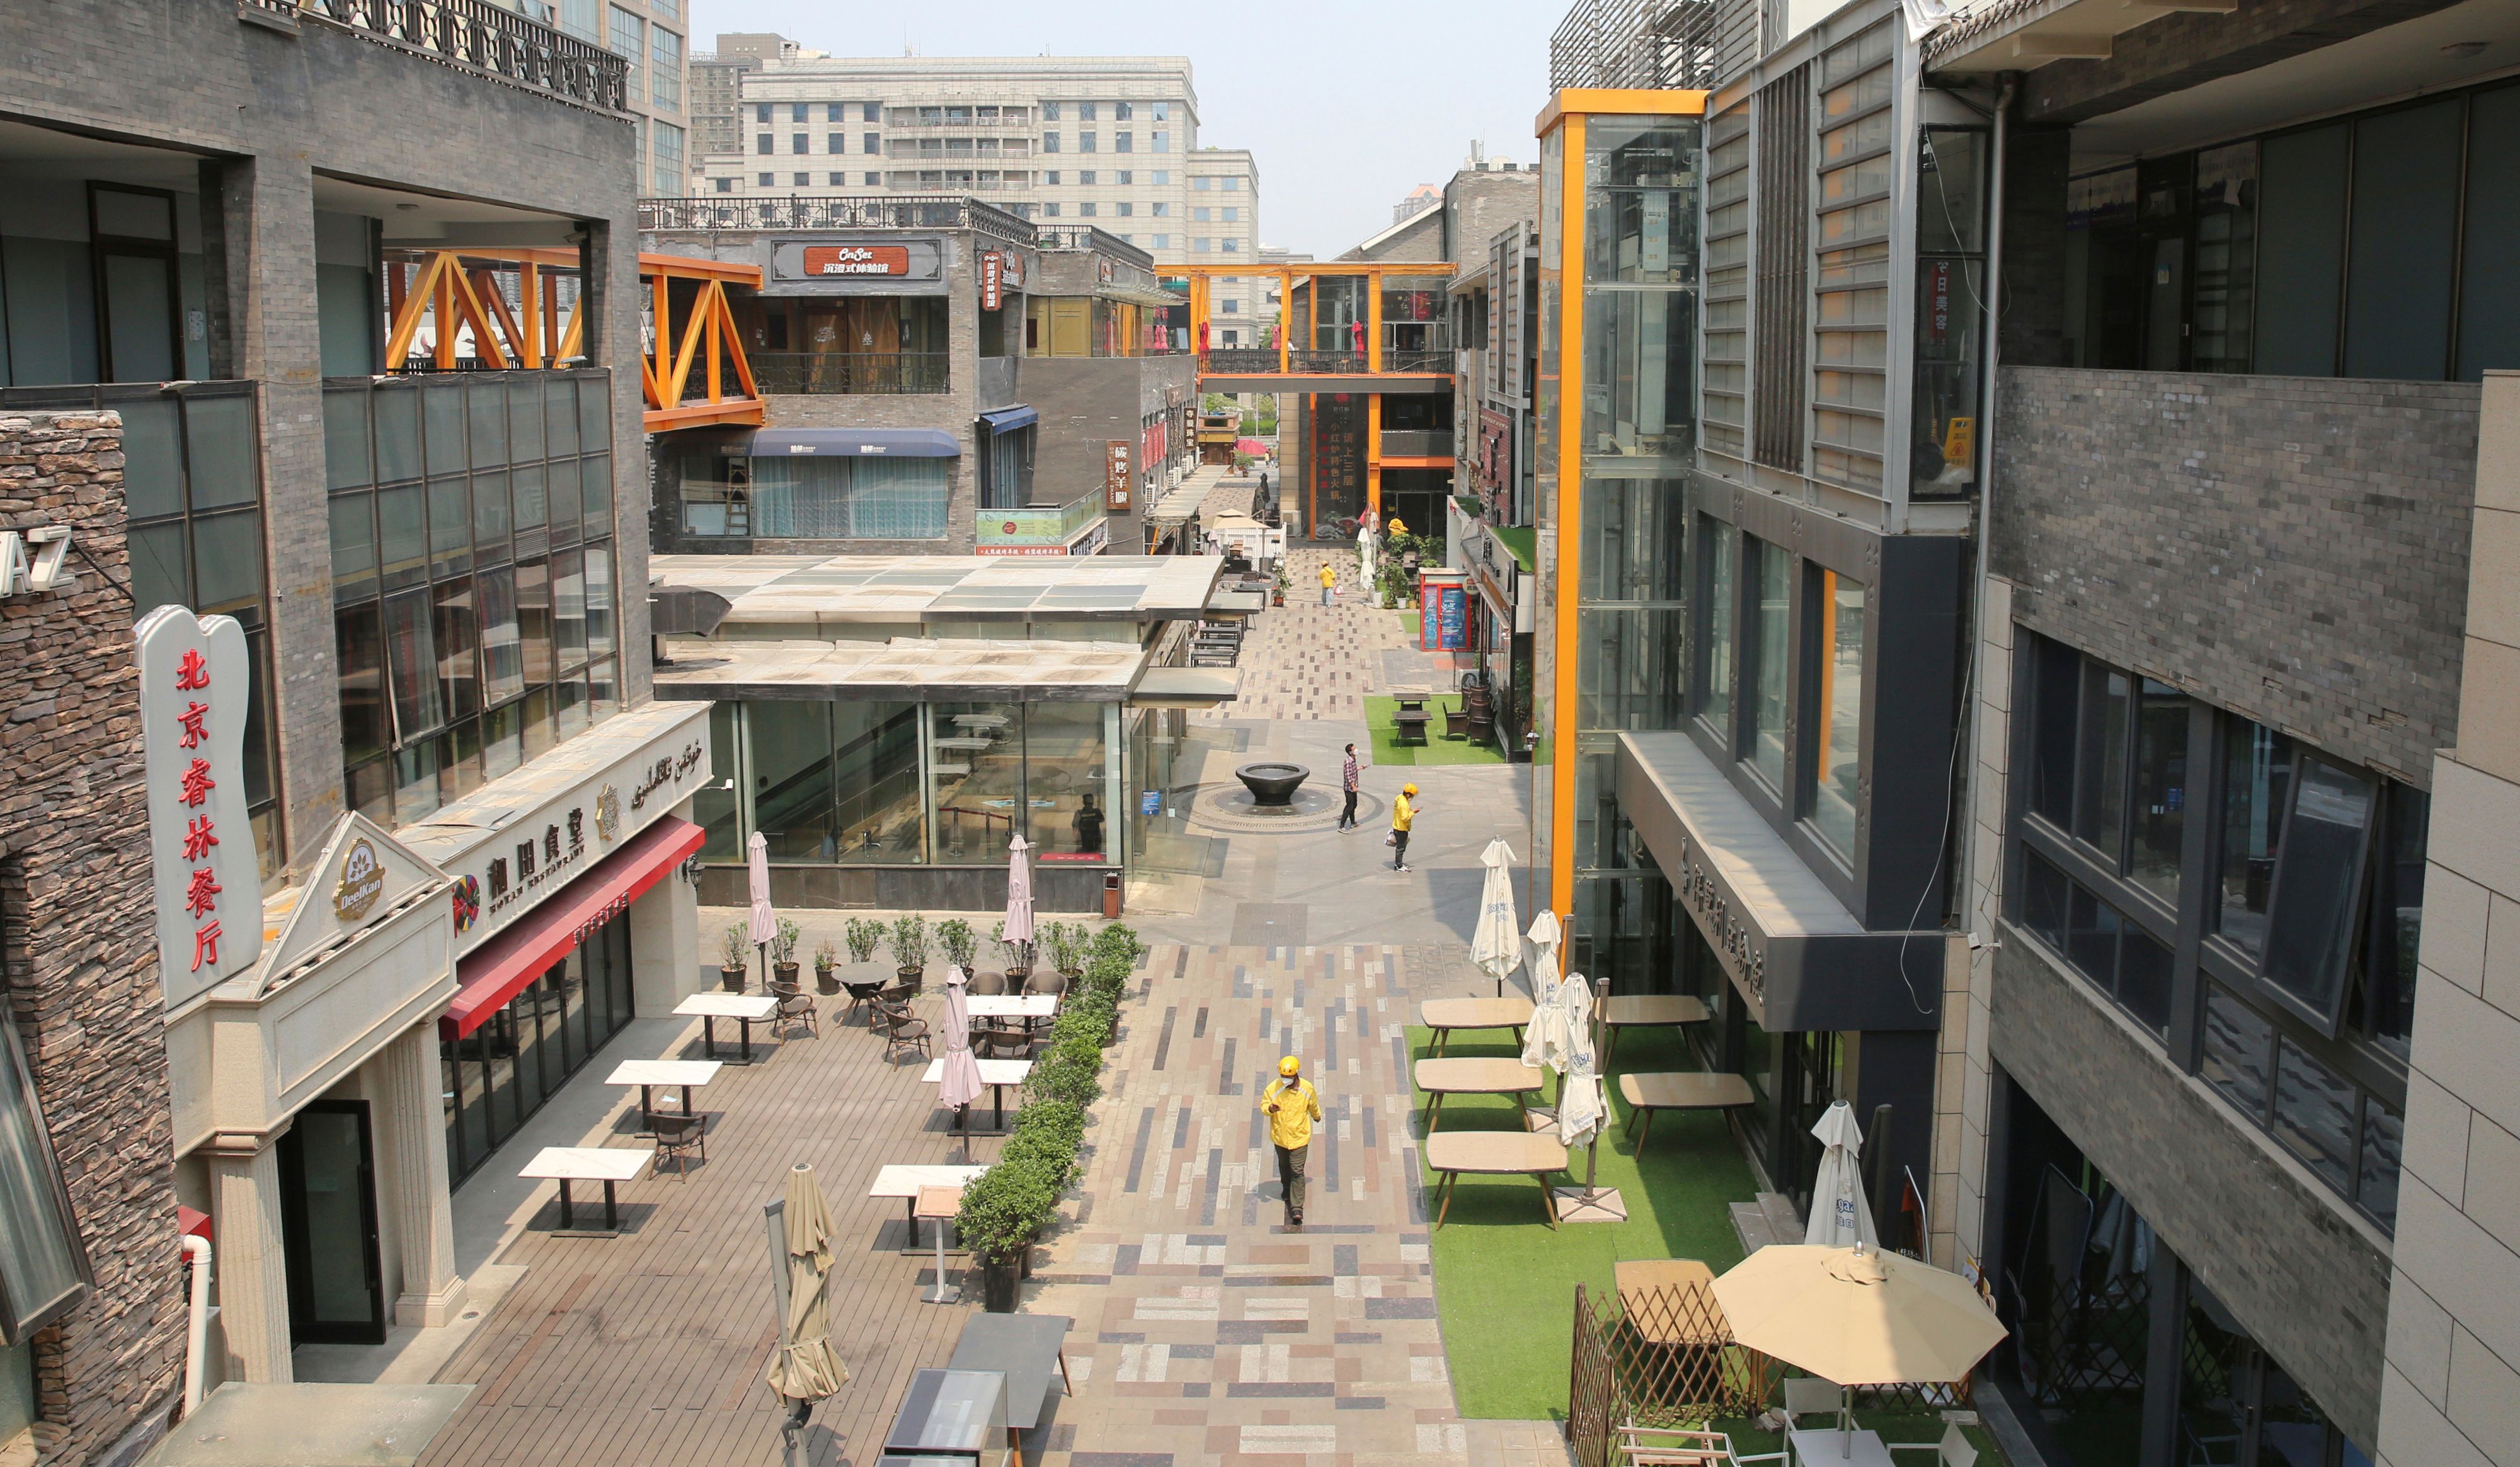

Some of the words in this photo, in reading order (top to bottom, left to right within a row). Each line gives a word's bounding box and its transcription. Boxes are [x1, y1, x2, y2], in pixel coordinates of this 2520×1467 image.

[823, 263, 889, 273] 沉浸式体验馆
[1114, 447, 1128, 505] 碳烤羊腿
[1330, 423, 1341, 500] 小红炉特色火锅
[1343, 433, 1354, 486] 请上三层
[175, 648, 224, 974] 北京睿林餐厅
[487, 808, 585, 901] 和田食堂
[489, 886, 524, 916] HOTAN
[528, 845, 585, 890] RESTAURANT
[341, 879, 381, 911] DeelKan
